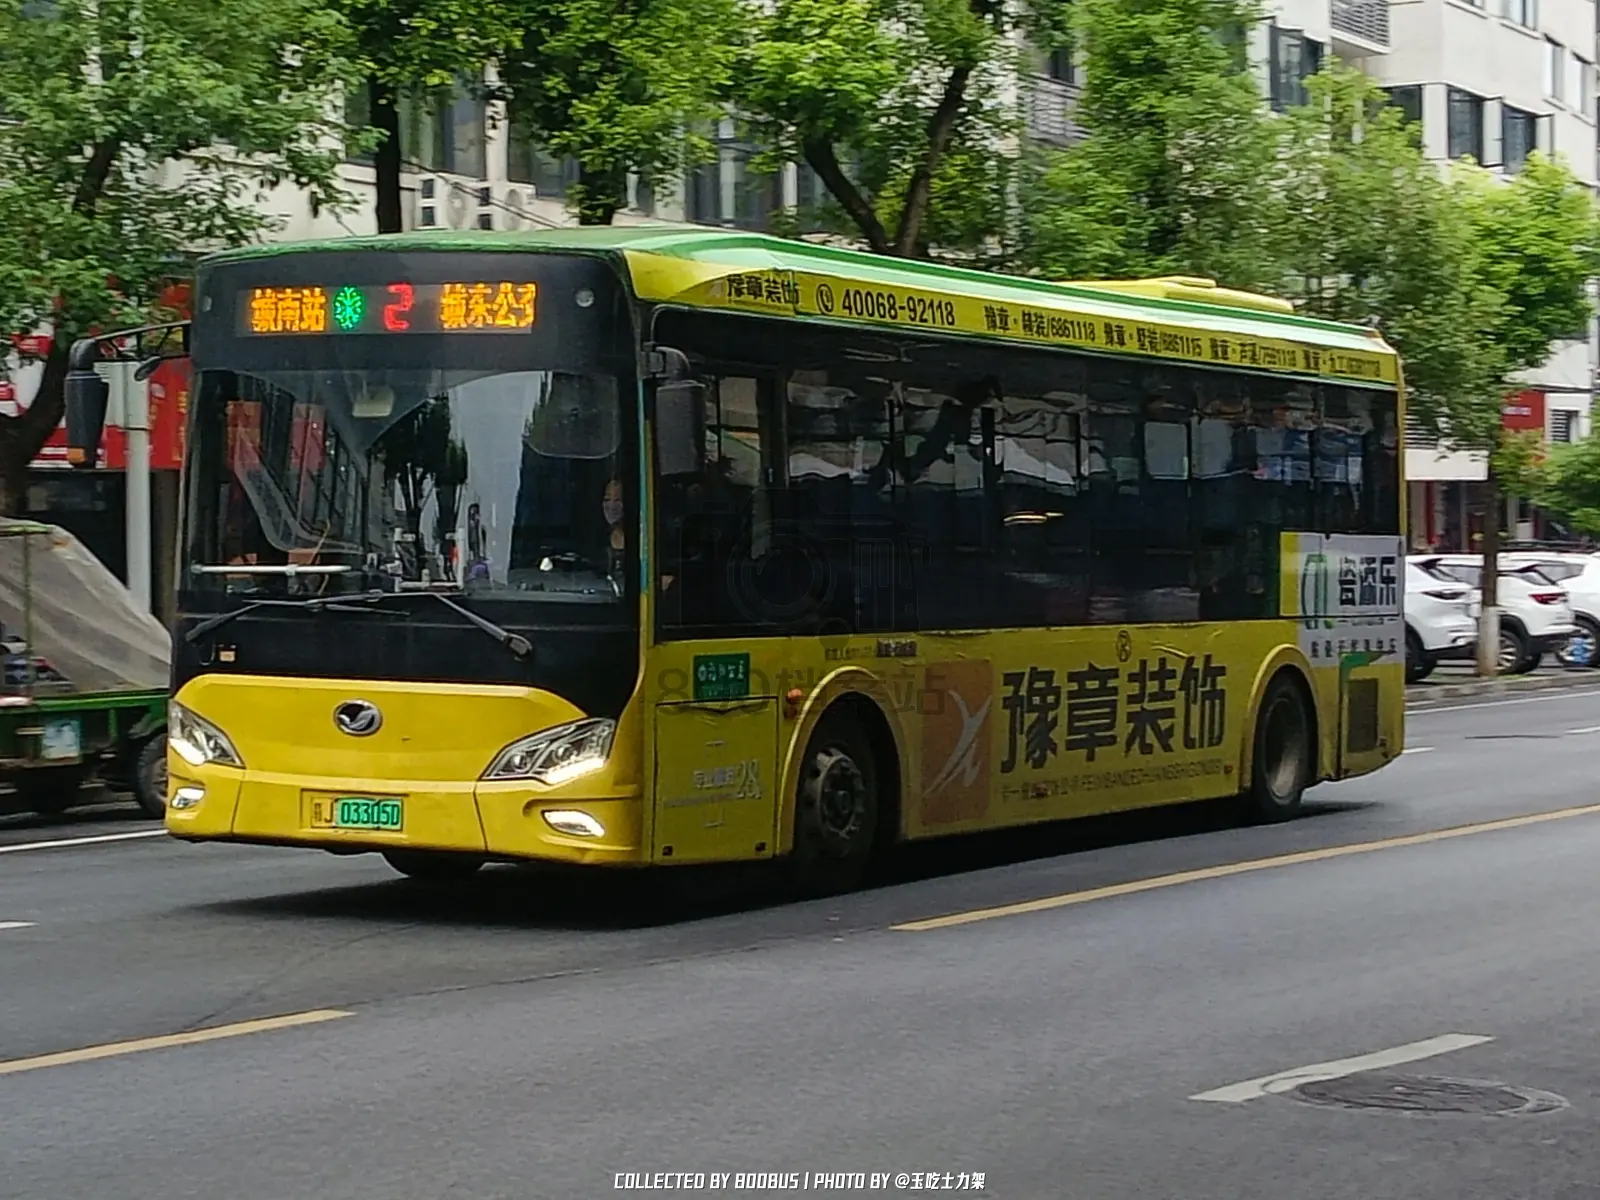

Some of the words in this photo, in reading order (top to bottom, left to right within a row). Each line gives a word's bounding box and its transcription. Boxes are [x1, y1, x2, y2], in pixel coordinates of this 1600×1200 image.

[384, 282, 412, 330] 2
[726, 274, 801, 304] 豫章装饰
[841, 289, 955, 326] 40068-92118
[1000, 654, 1227, 774] 豫章装饰
